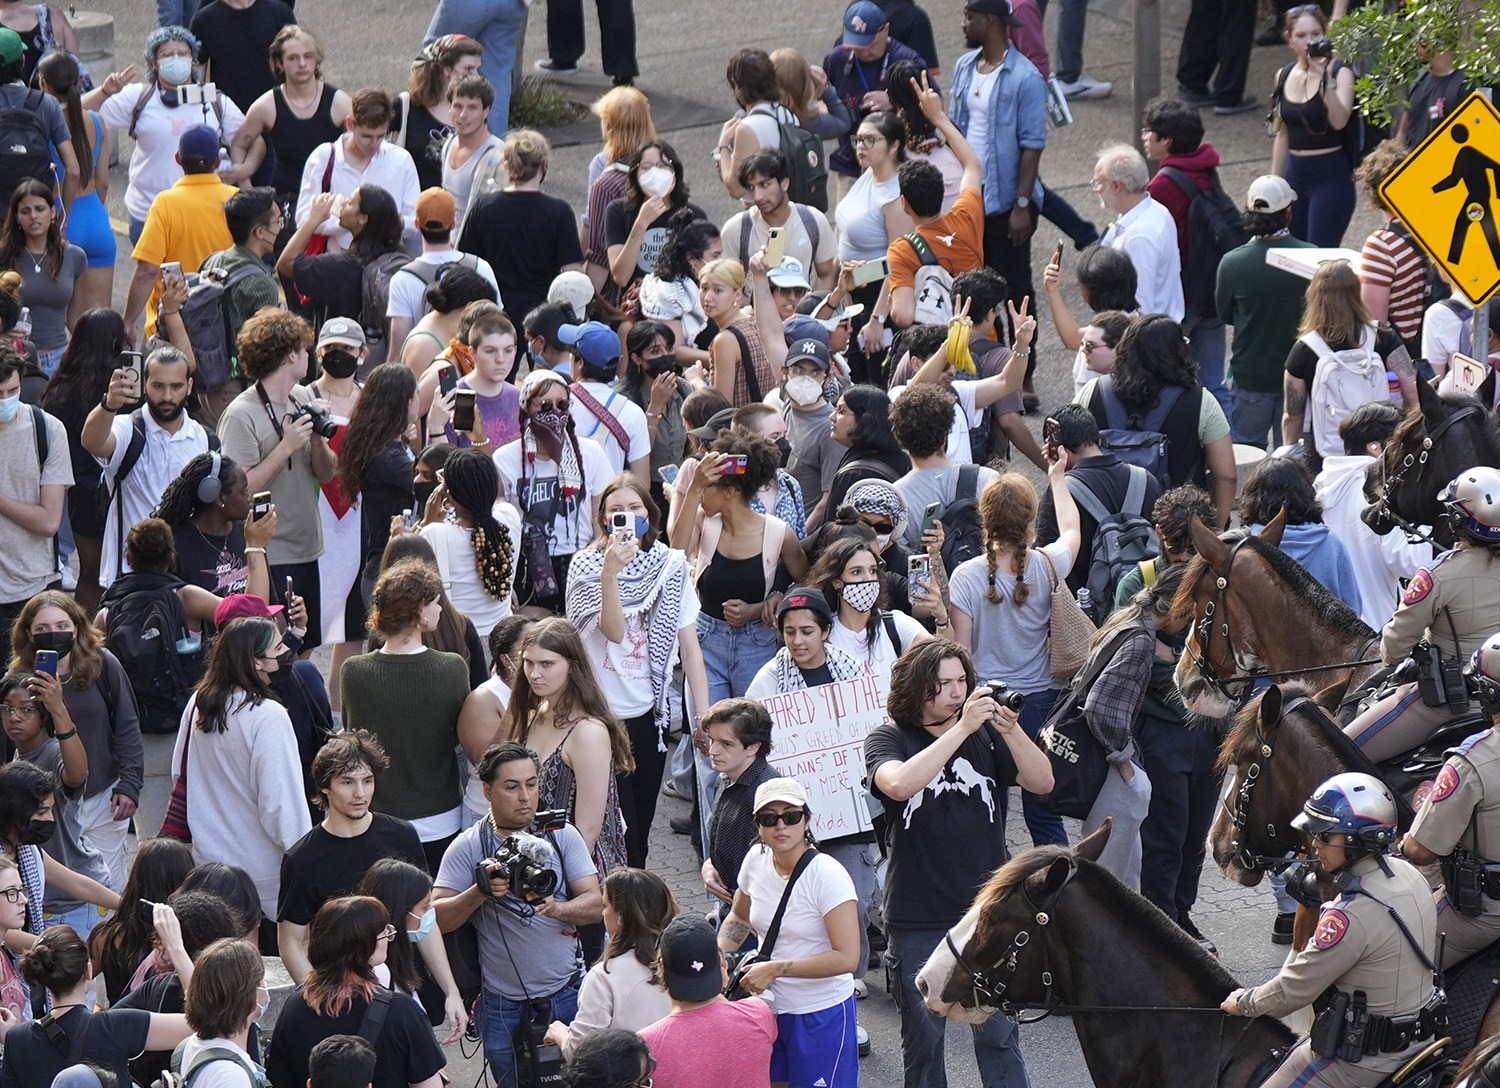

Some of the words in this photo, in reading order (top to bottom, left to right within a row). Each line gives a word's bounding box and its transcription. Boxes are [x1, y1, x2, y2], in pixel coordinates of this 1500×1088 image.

[763, 690, 815, 729] PARED
[827, 683, 846, 720] TO
[847, 675, 887, 713] THE
[832, 749, 849, 767] OF
